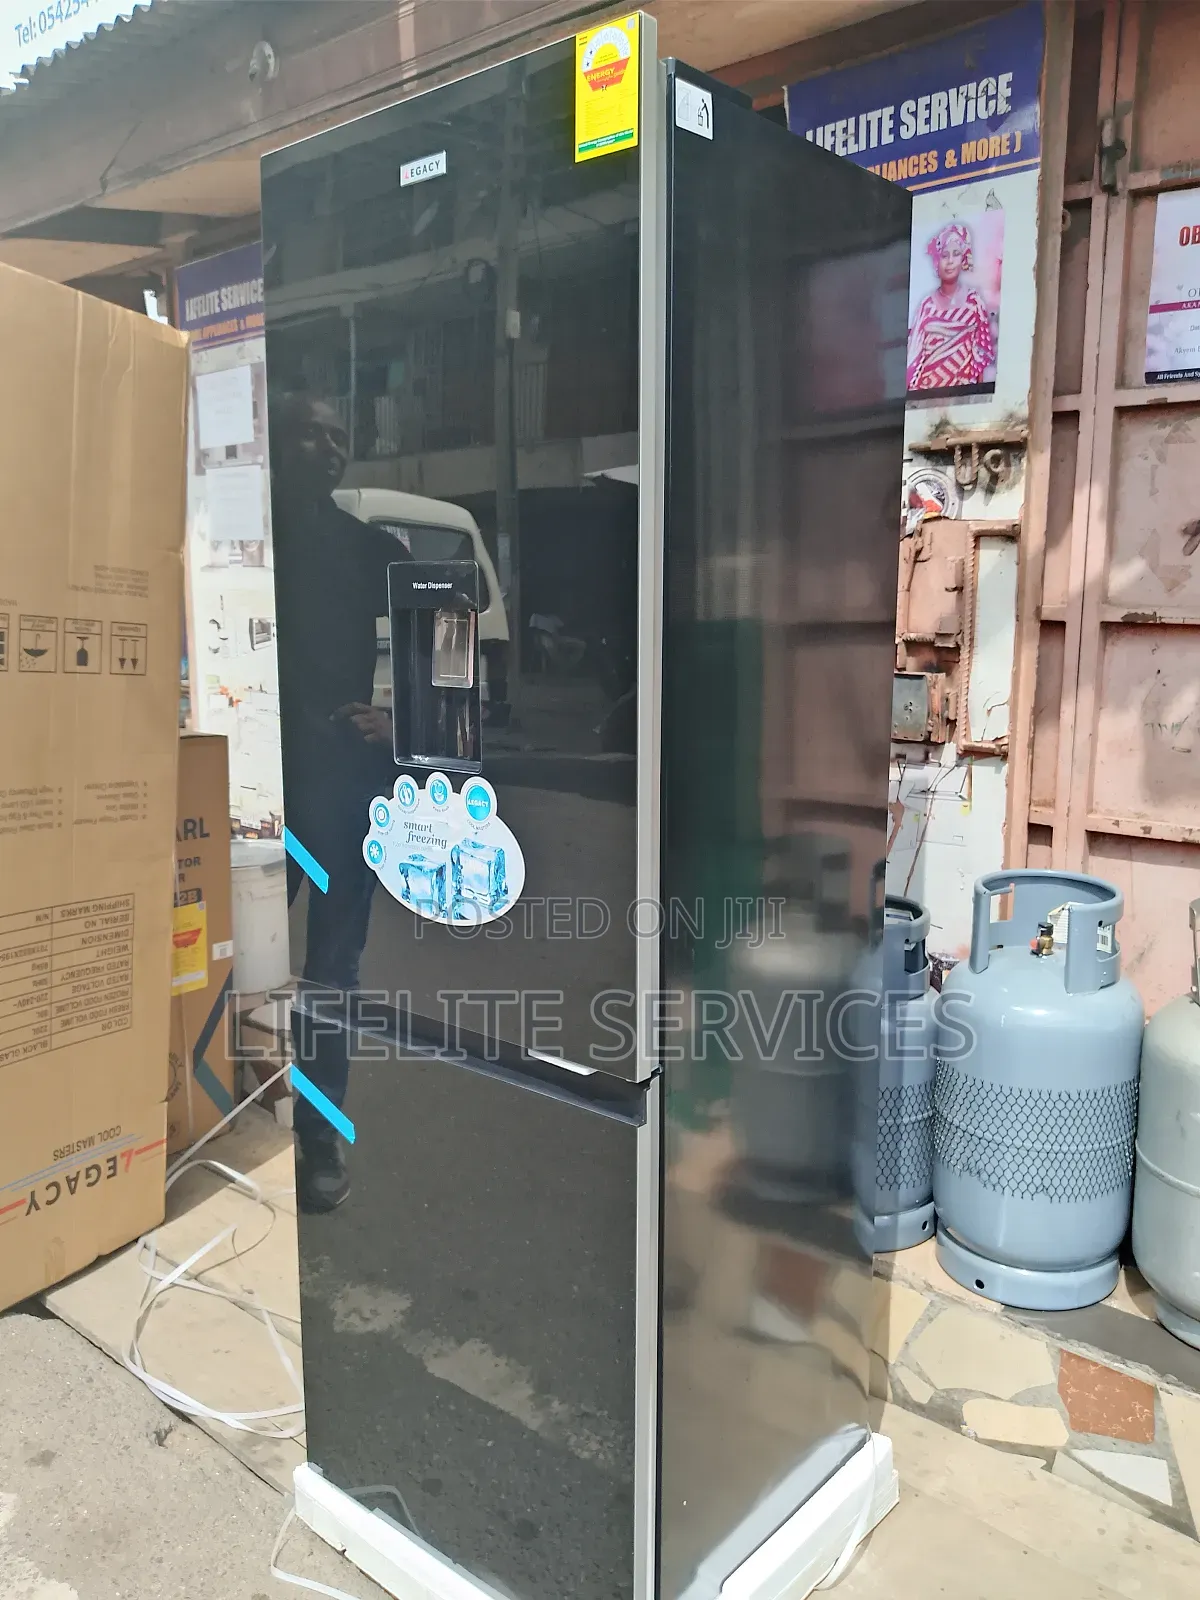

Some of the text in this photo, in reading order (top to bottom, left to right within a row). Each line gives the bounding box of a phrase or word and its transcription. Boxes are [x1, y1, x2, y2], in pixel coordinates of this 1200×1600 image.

[15, 16, 37, 47] Tel:
[899, 72, 1013, 141] SERVICE
[944, 148, 957, 168] &
[961, 134, 1010, 165] MORE
[403, 160, 441, 180] LEGACY
[412, 581, 453, 591] Water Dispenser
[467, 798, 489, 808] LEGACY
[176, 816, 210, 842] RL
[403, 821, 433, 834] smart
[405, 831, 448, 850] freezing
[60, 899, 130, 919] SHIPPING MARKS
[84, 919, 97, 929] NO
[81, 929, 129, 945] DIMENSION
[95, 944, 129, 958] WEIGHT
[60, 959, 129, 981] RATED FREQUENCY
[71, 973, 129, 994] RATED VOLTAGE
[55, 1000, 82, 1014] VOLUME
[109, 1003, 130, 1016] FRESH
[60, 1014, 88, 1028] VOLUME
[101, 1017, 129, 1031] COLOR
[22, 1040, 48, 1056] BLACK
[53, 1125, 122, 1162] COOL MASTERS
[25, 1148, 135, 1217] LEGACY
